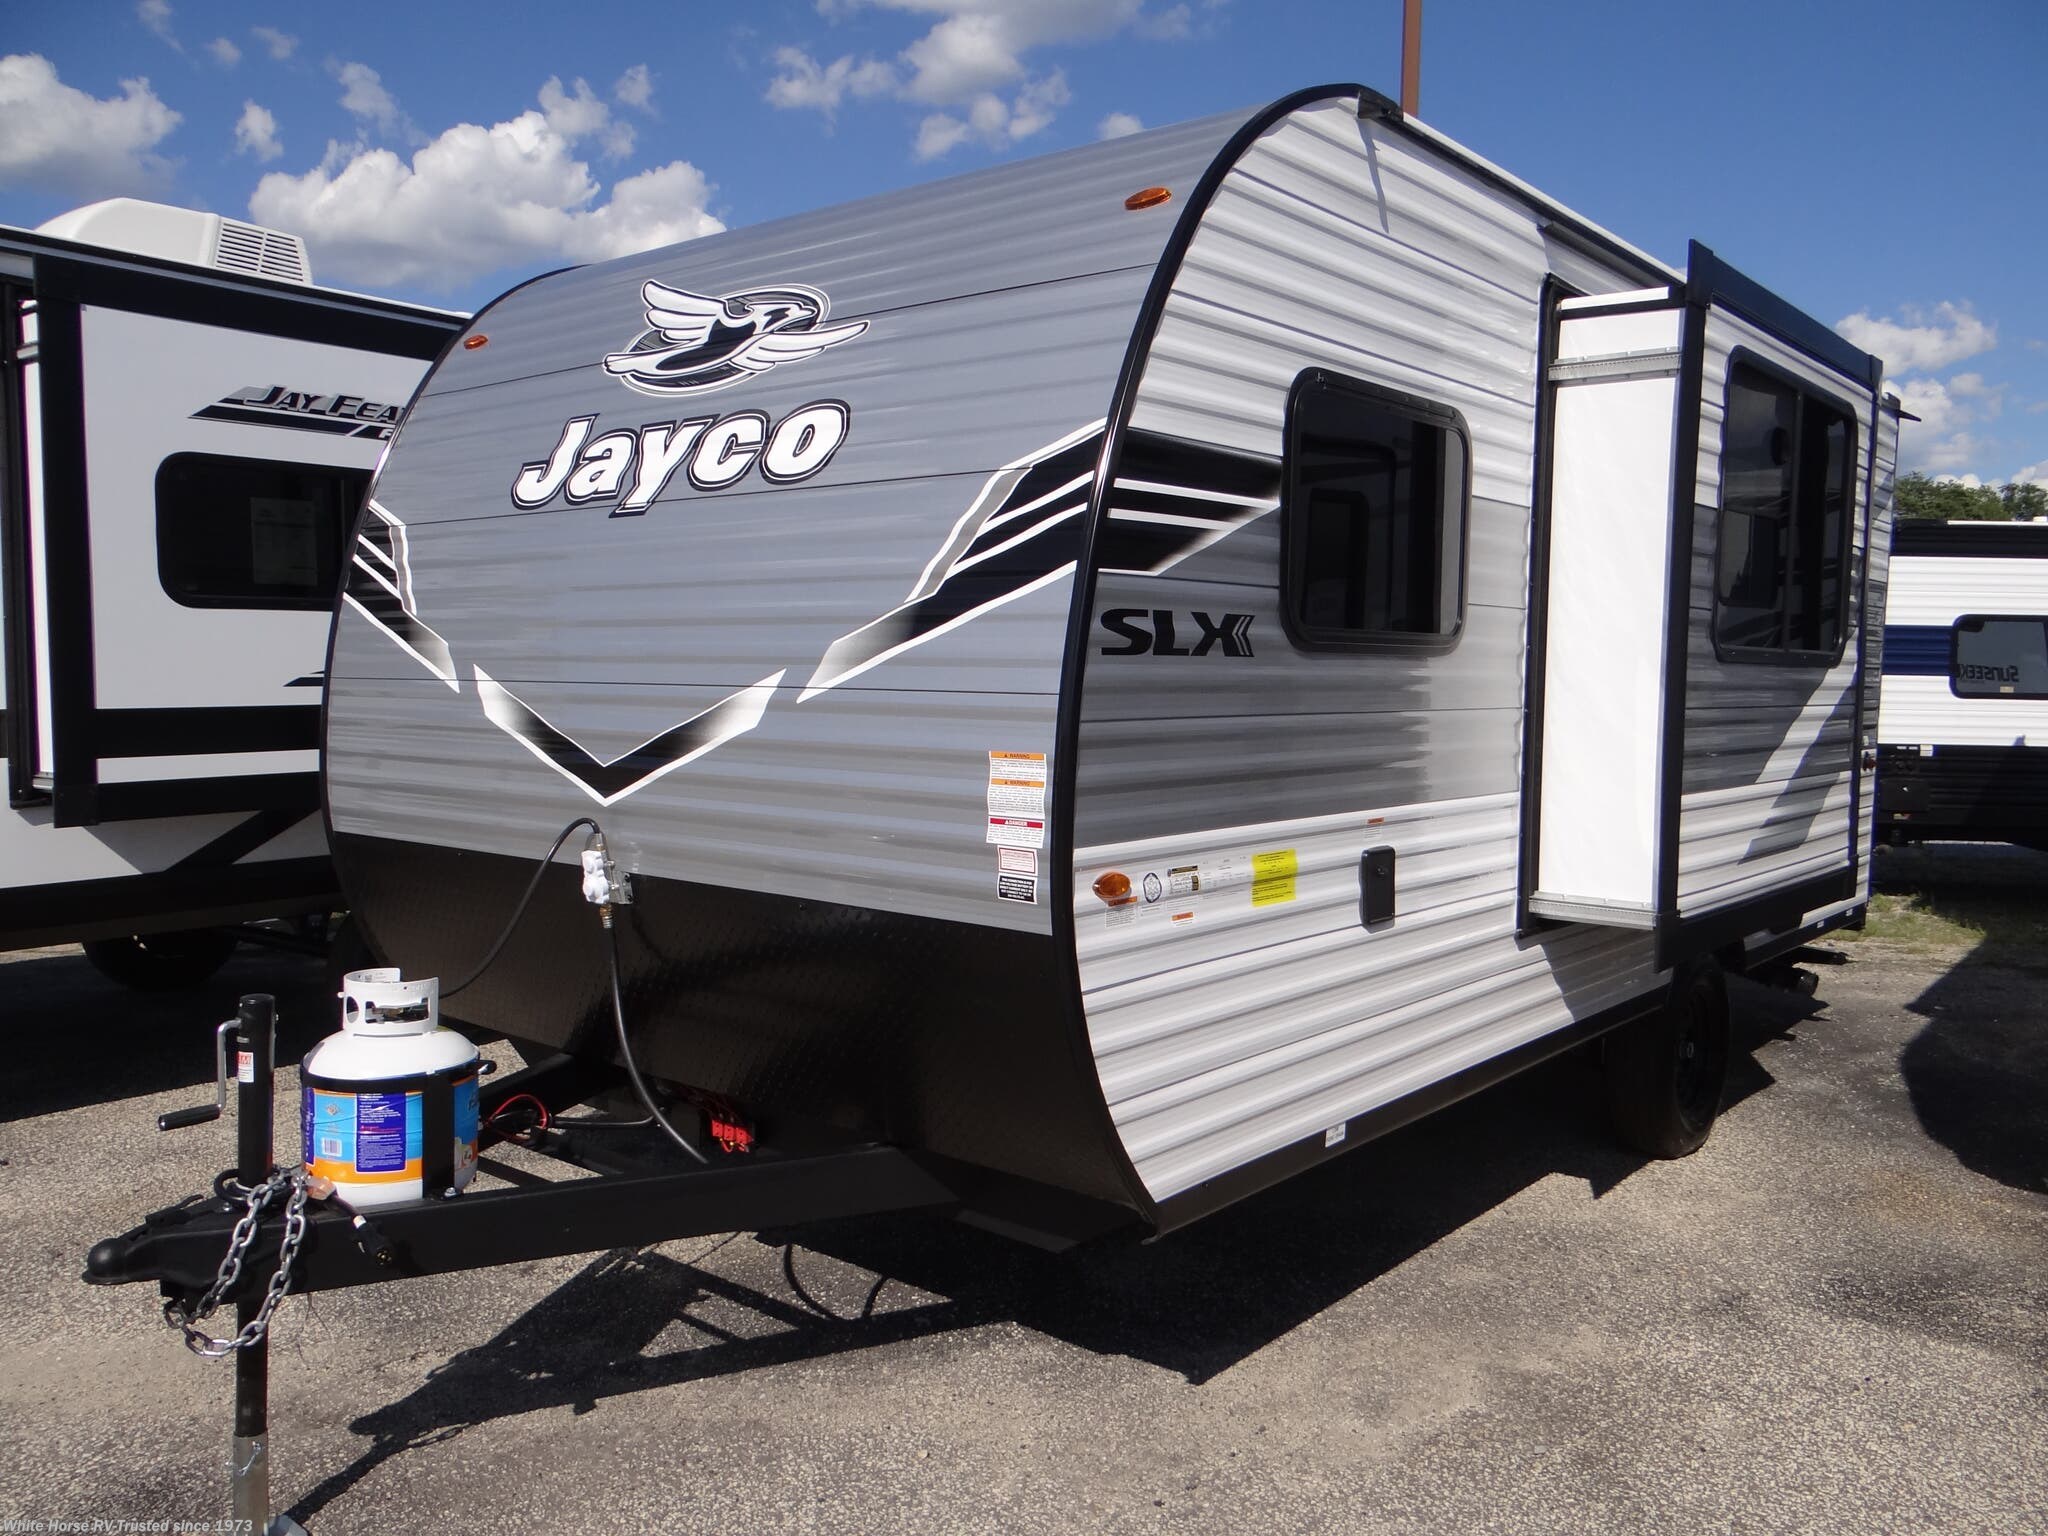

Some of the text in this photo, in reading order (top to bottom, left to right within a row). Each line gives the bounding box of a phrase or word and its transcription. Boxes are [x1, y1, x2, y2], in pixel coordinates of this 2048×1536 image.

[325, 393, 405, 423] FEA
[511, 398, 851, 518] Jayco
[1101, 608, 1255, 658] SLX
